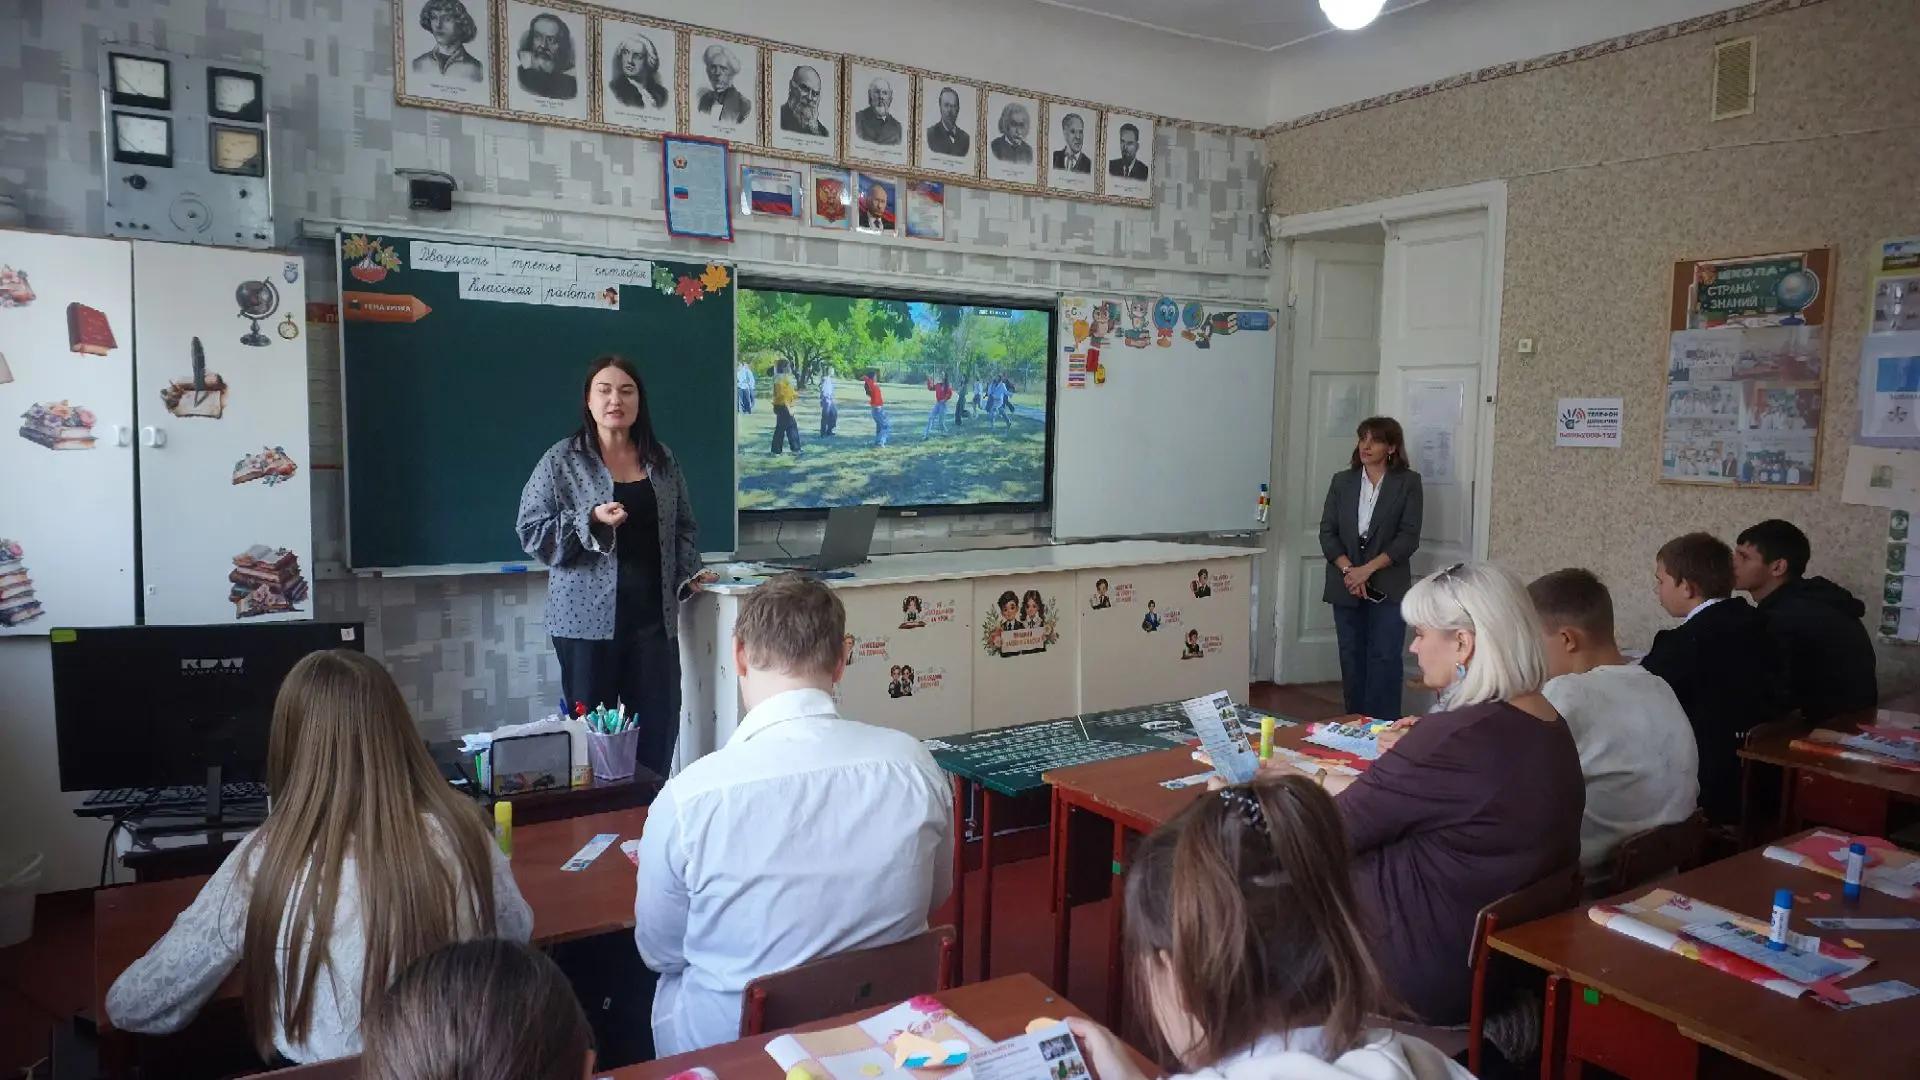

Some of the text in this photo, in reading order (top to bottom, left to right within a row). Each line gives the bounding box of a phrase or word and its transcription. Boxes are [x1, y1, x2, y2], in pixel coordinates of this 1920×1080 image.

[418, 246, 647, 284] Двадцать третье октября
[467, 277, 596, 302] Классная работа
[1709, 296, 1758, 309] ЗНАНИЙ
